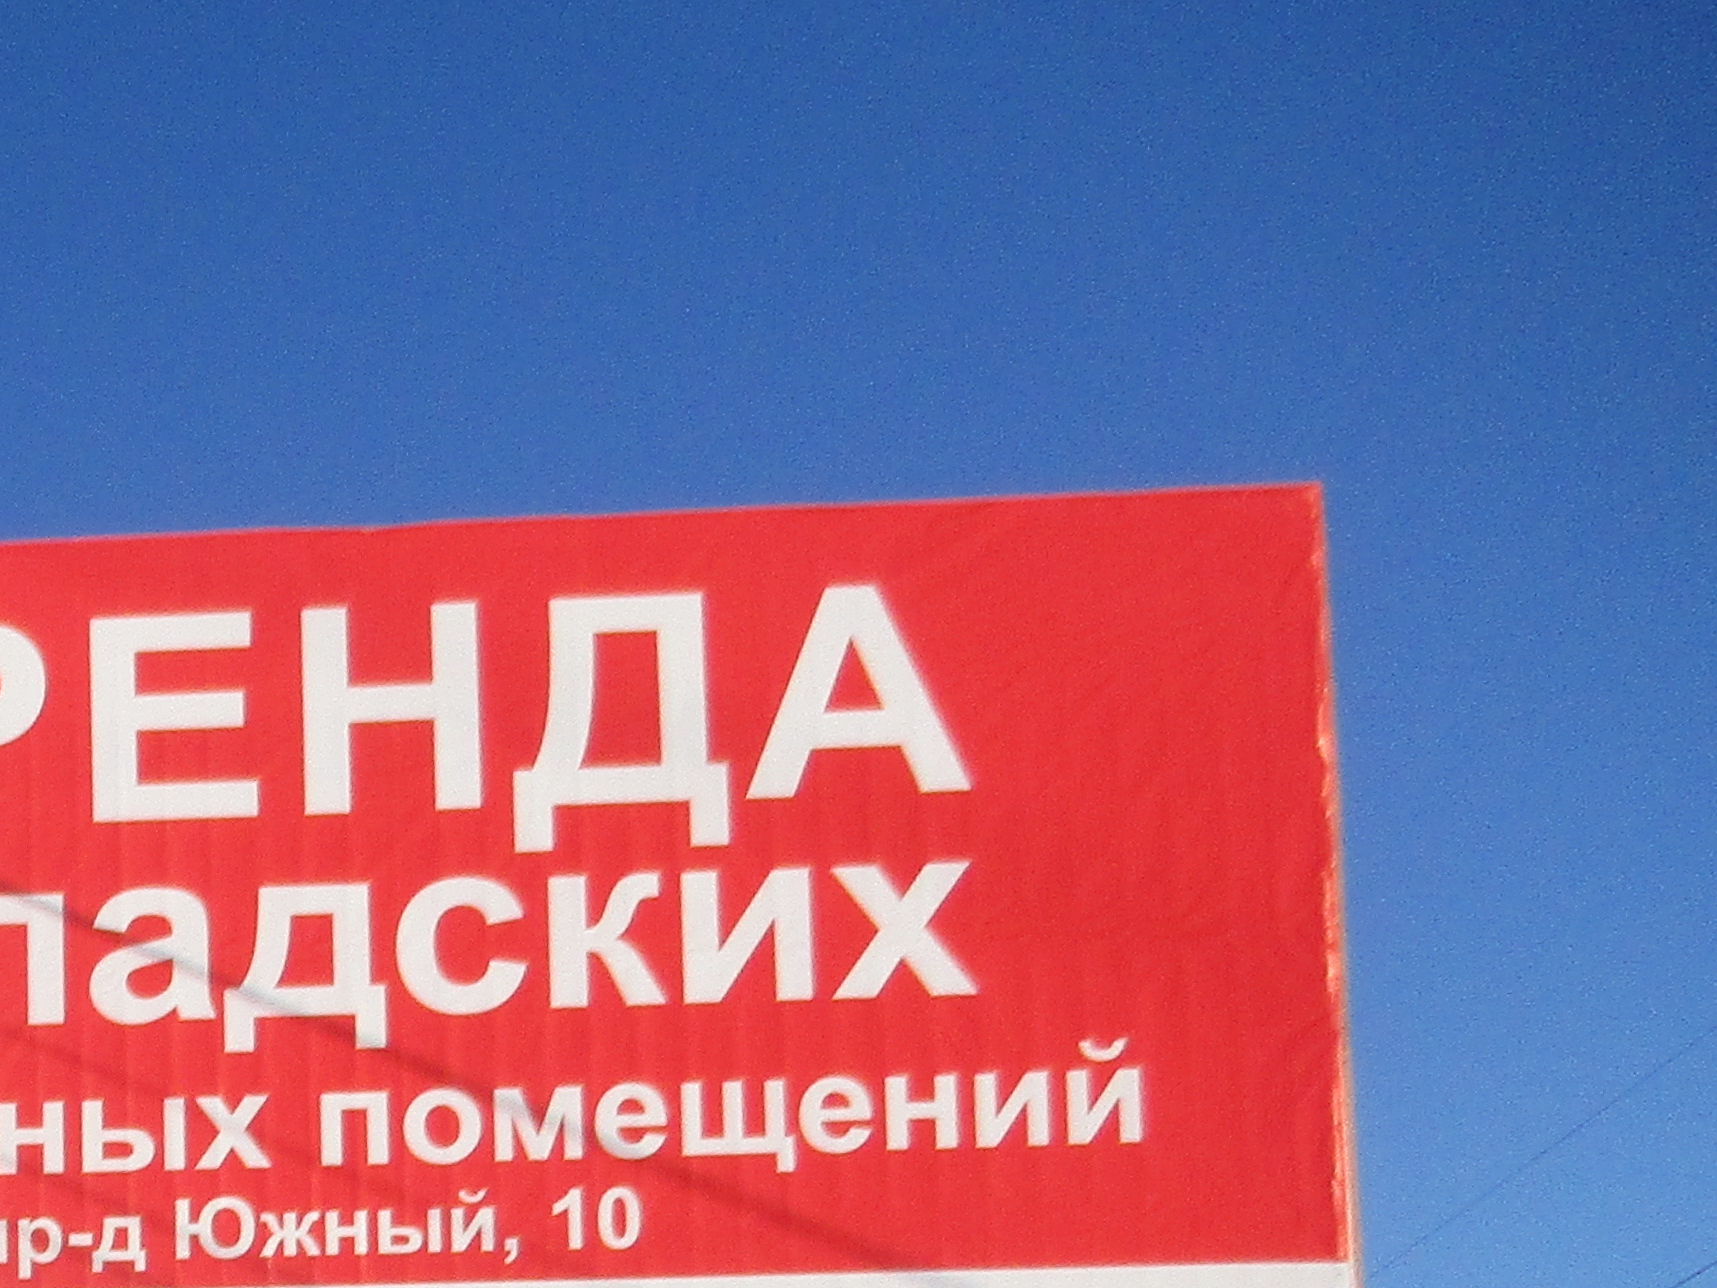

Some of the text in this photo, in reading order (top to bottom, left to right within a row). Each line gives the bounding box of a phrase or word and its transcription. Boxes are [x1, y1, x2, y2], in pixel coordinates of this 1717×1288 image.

[320, 1038, 1144, 1180] помещений
[175, 1193, 525, 1265] Южный,
[552, 1187, 643, 1251] 10
